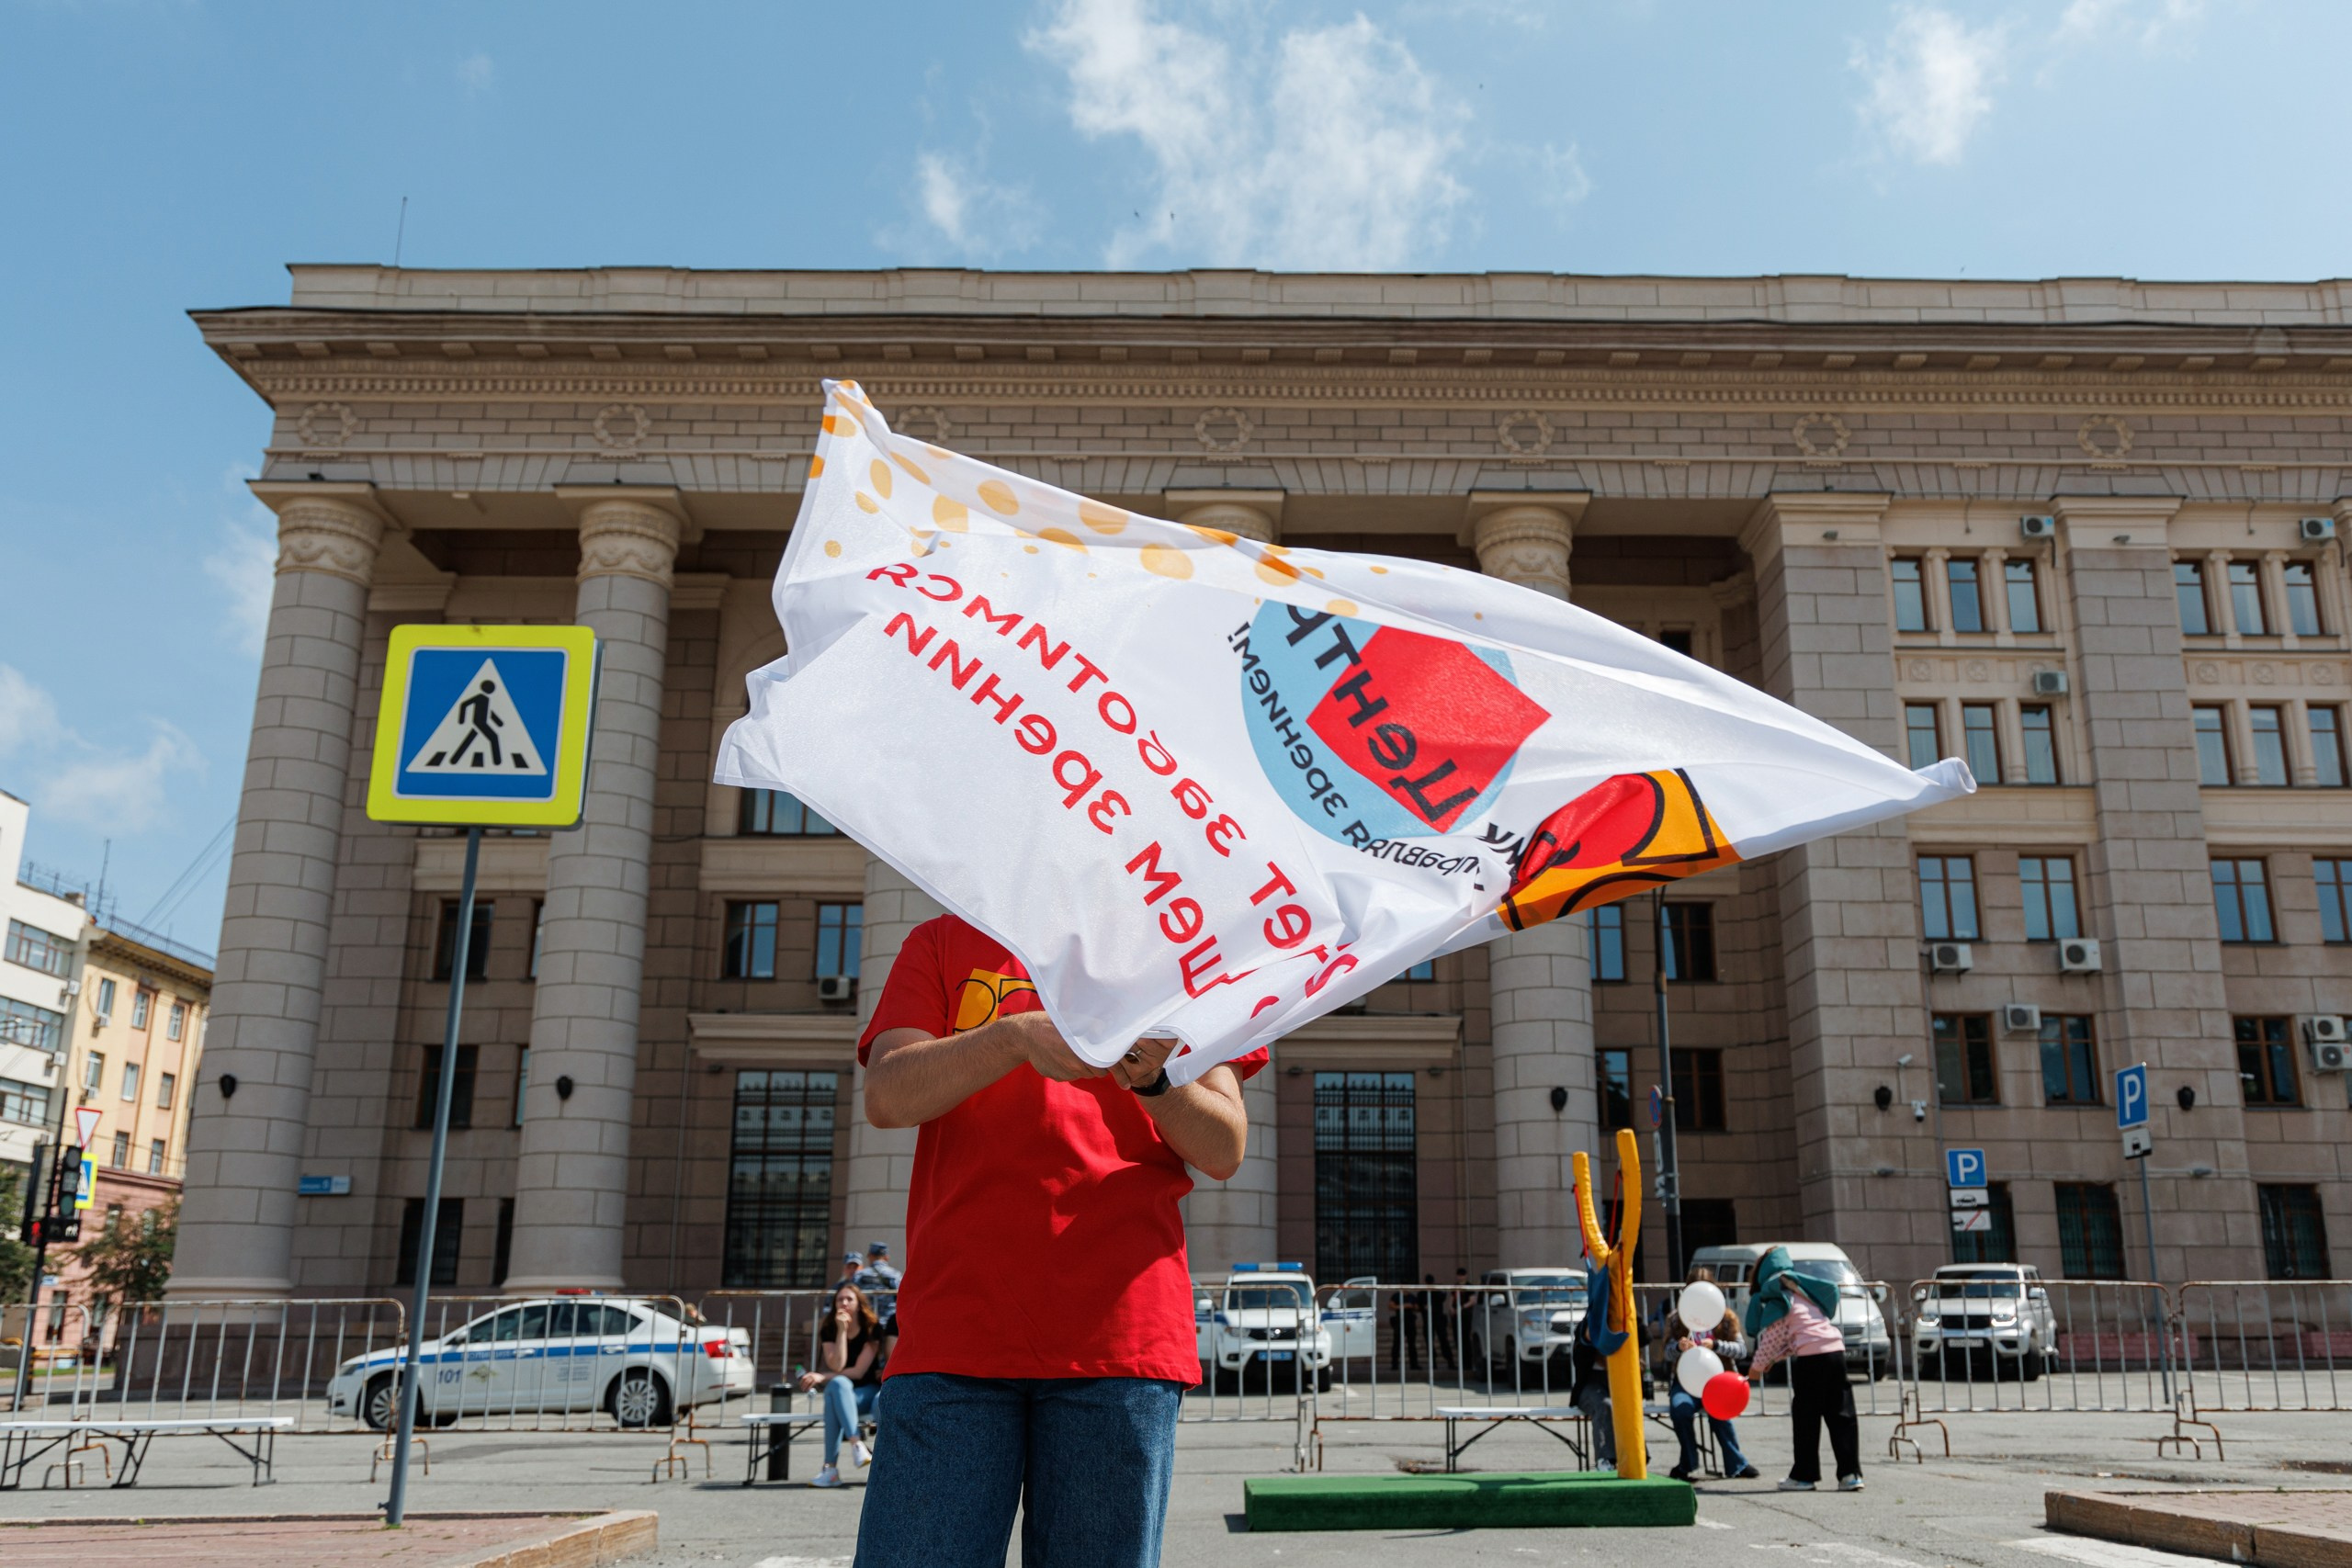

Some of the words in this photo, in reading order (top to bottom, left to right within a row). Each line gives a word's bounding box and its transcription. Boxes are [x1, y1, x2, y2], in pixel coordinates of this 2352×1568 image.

[2123, 1073, 2142, 1120] P
[1958, 1153, 1978, 1183] P
[437, 1369, 461, 1384] 101
